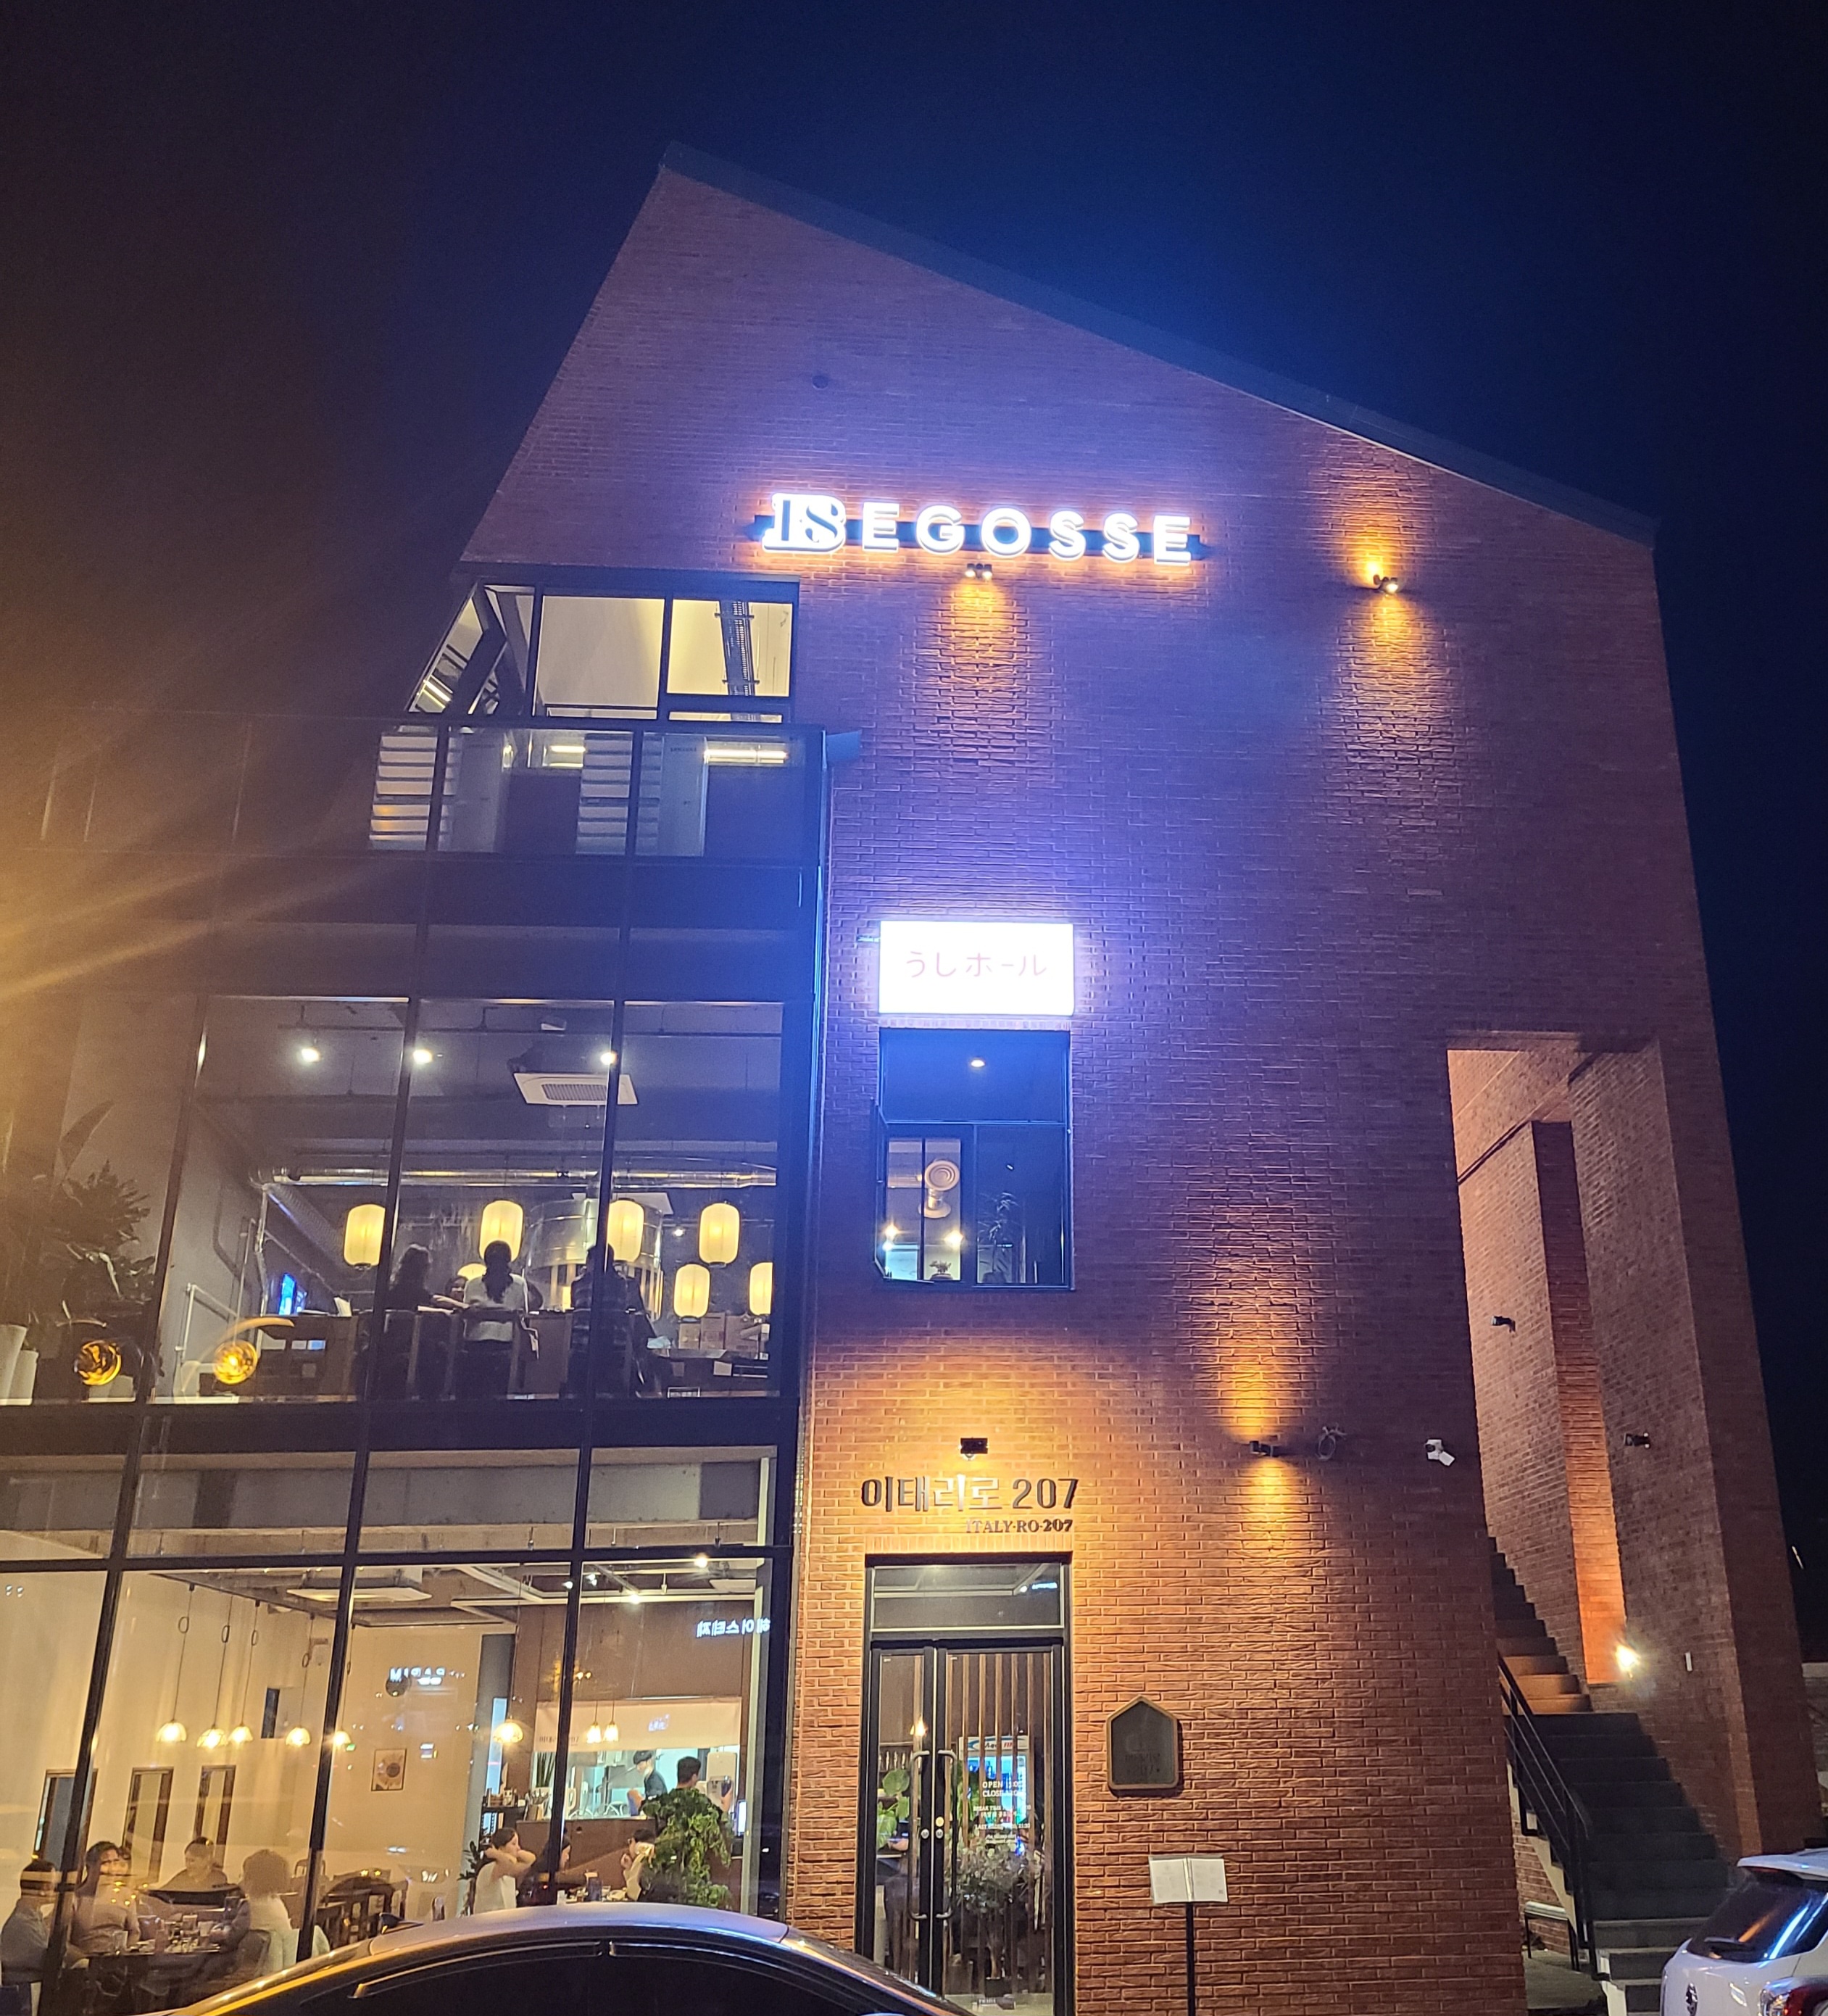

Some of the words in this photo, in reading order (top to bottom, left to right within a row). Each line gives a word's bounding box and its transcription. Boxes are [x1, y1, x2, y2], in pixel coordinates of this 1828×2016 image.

[906, 951, 1047, 977] うしホール
[861, 1474, 1002, 1511] 이태리로
[1012, 1478, 1079, 1509] 207
